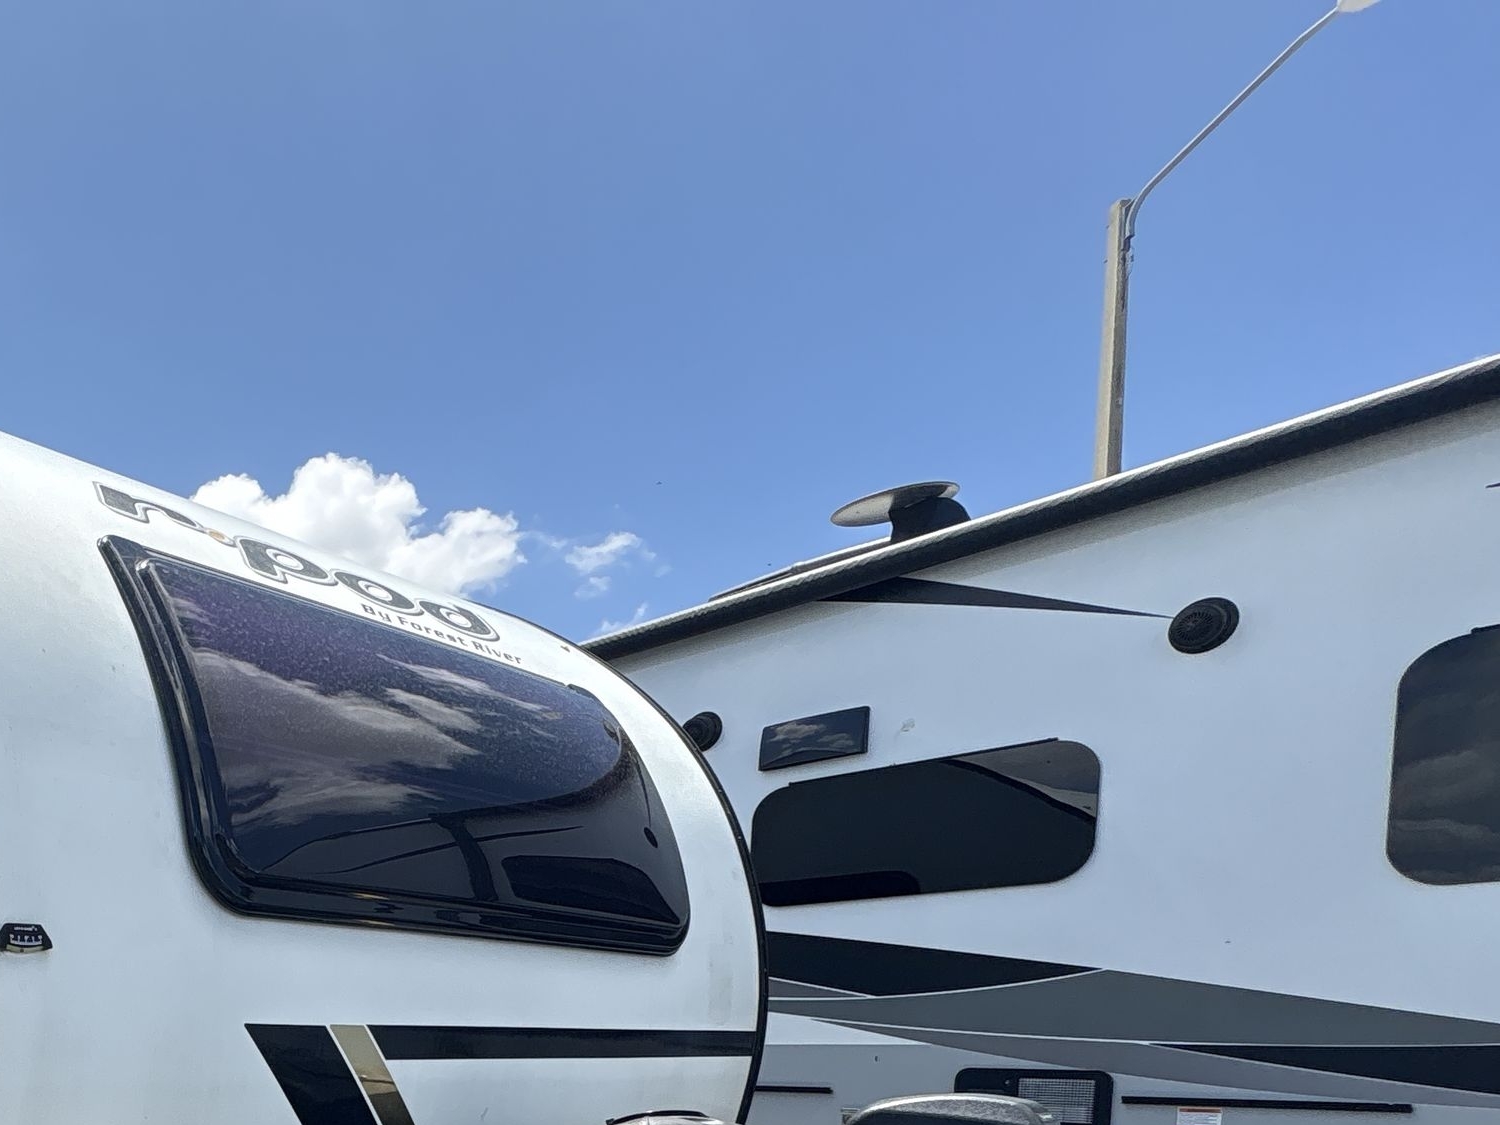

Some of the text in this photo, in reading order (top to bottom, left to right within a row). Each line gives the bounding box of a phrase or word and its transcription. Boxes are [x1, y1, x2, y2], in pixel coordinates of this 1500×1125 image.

[361, 603, 523, 665] By Forest River
